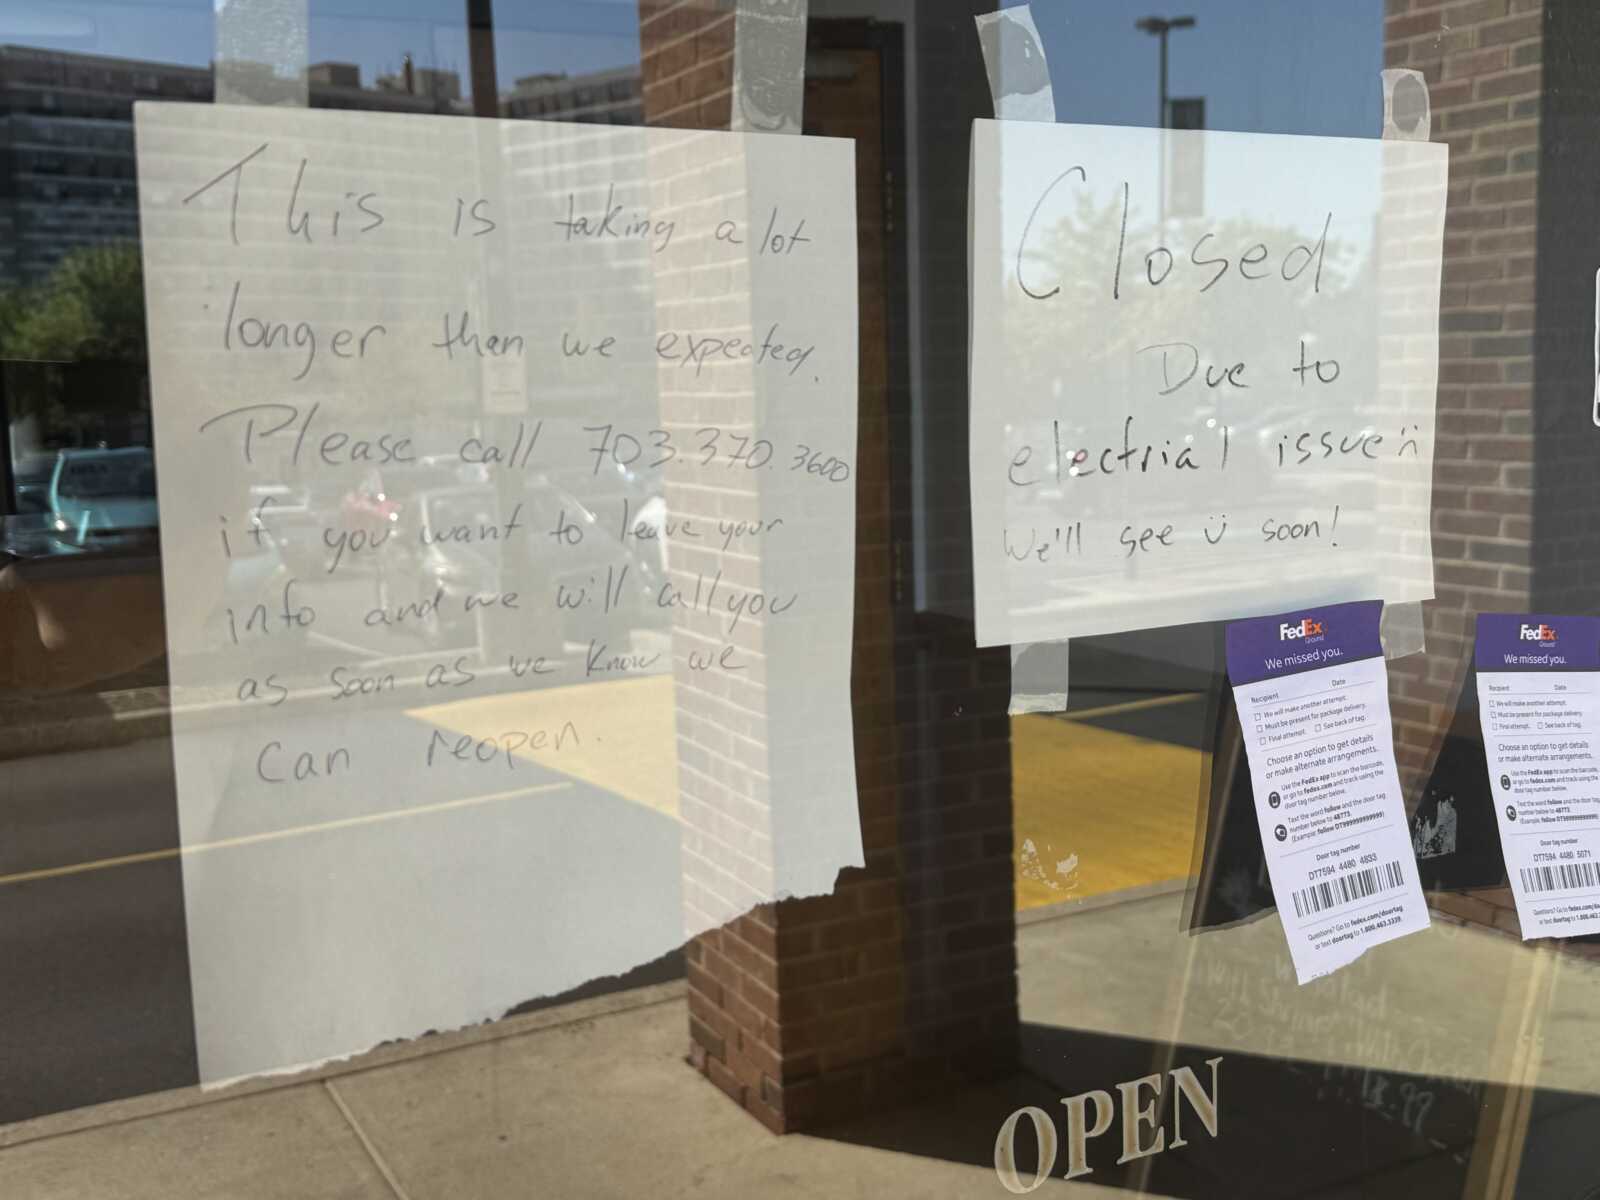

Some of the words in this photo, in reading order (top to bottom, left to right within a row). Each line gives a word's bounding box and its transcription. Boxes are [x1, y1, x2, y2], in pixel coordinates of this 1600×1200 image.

[183, 143, 384, 246] This
[453, 198, 497, 237] is
[555, 183, 676, 252] taking
[715, 220, 744, 245] a
[758, 207, 811, 256] lot
[1016, 165, 1332, 300] Closed
[224, 281, 387, 381] longer
[432, 311, 523, 359] than
[561, 332, 617, 358] we
[1136, 342, 1250, 396] Due
[1292, 340, 1341, 388] to
[199, 403, 416, 466] Please
[459, 421, 542, 469] call
[220, 496, 277, 558] if
[324, 525, 392, 574] you
[420, 504, 522, 546] want
[549, 510, 584, 546] to
[621, 498, 700, 543] leave
[718, 517, 783, 551] your
[1003, 521, 1082, 563] We'll
[1119, 523, 1174, 559] see
[1261, 505, 1340, 548] soon!
[226, 578, 316, 645] info
[364, 588, 443, 627] and
[464, 588, 519, 613] we
[556, 565, 628, 614] will
[657, 570, 722, 616] call
[727, 592, 798, 632] you
[1279, 618, 1323, 641] FedEx
[1520, 624, 1557, 640] FedEx
[238, 673, 288, 706] as
[426, 655, 475, 688] as
[509, 655, 556, 679] we
[688, 645, 748, 671] we
[1265, 657, 1283, 670] We
[1284, 649, 1320, 667] missed
[1322, 646, 1344, 661] you.
[1331, 678, 1346, 686] Date
[1504, 654, 1518, 664] We
[1520, 653, 1548, 664] missed
[1549, 656, 1567, 667] you.
[1266, 752, 1292, 766] Choose
[1303, 744, 1327, 759] option
[1327, 742, 1335, 751] to
[1336, 739, 1349, 751] get
[1349, 733, 1373, 746] details
[1273, 765, 1292, 776] make
[1293, 757, 1326, 771] alternate
[1315, 851, 1329, 860] Door
[1329, 848, 1339, 858] tag
[1339, 842, 1360, 853] number
[994, 1056, 1223, 1194] OPEN
